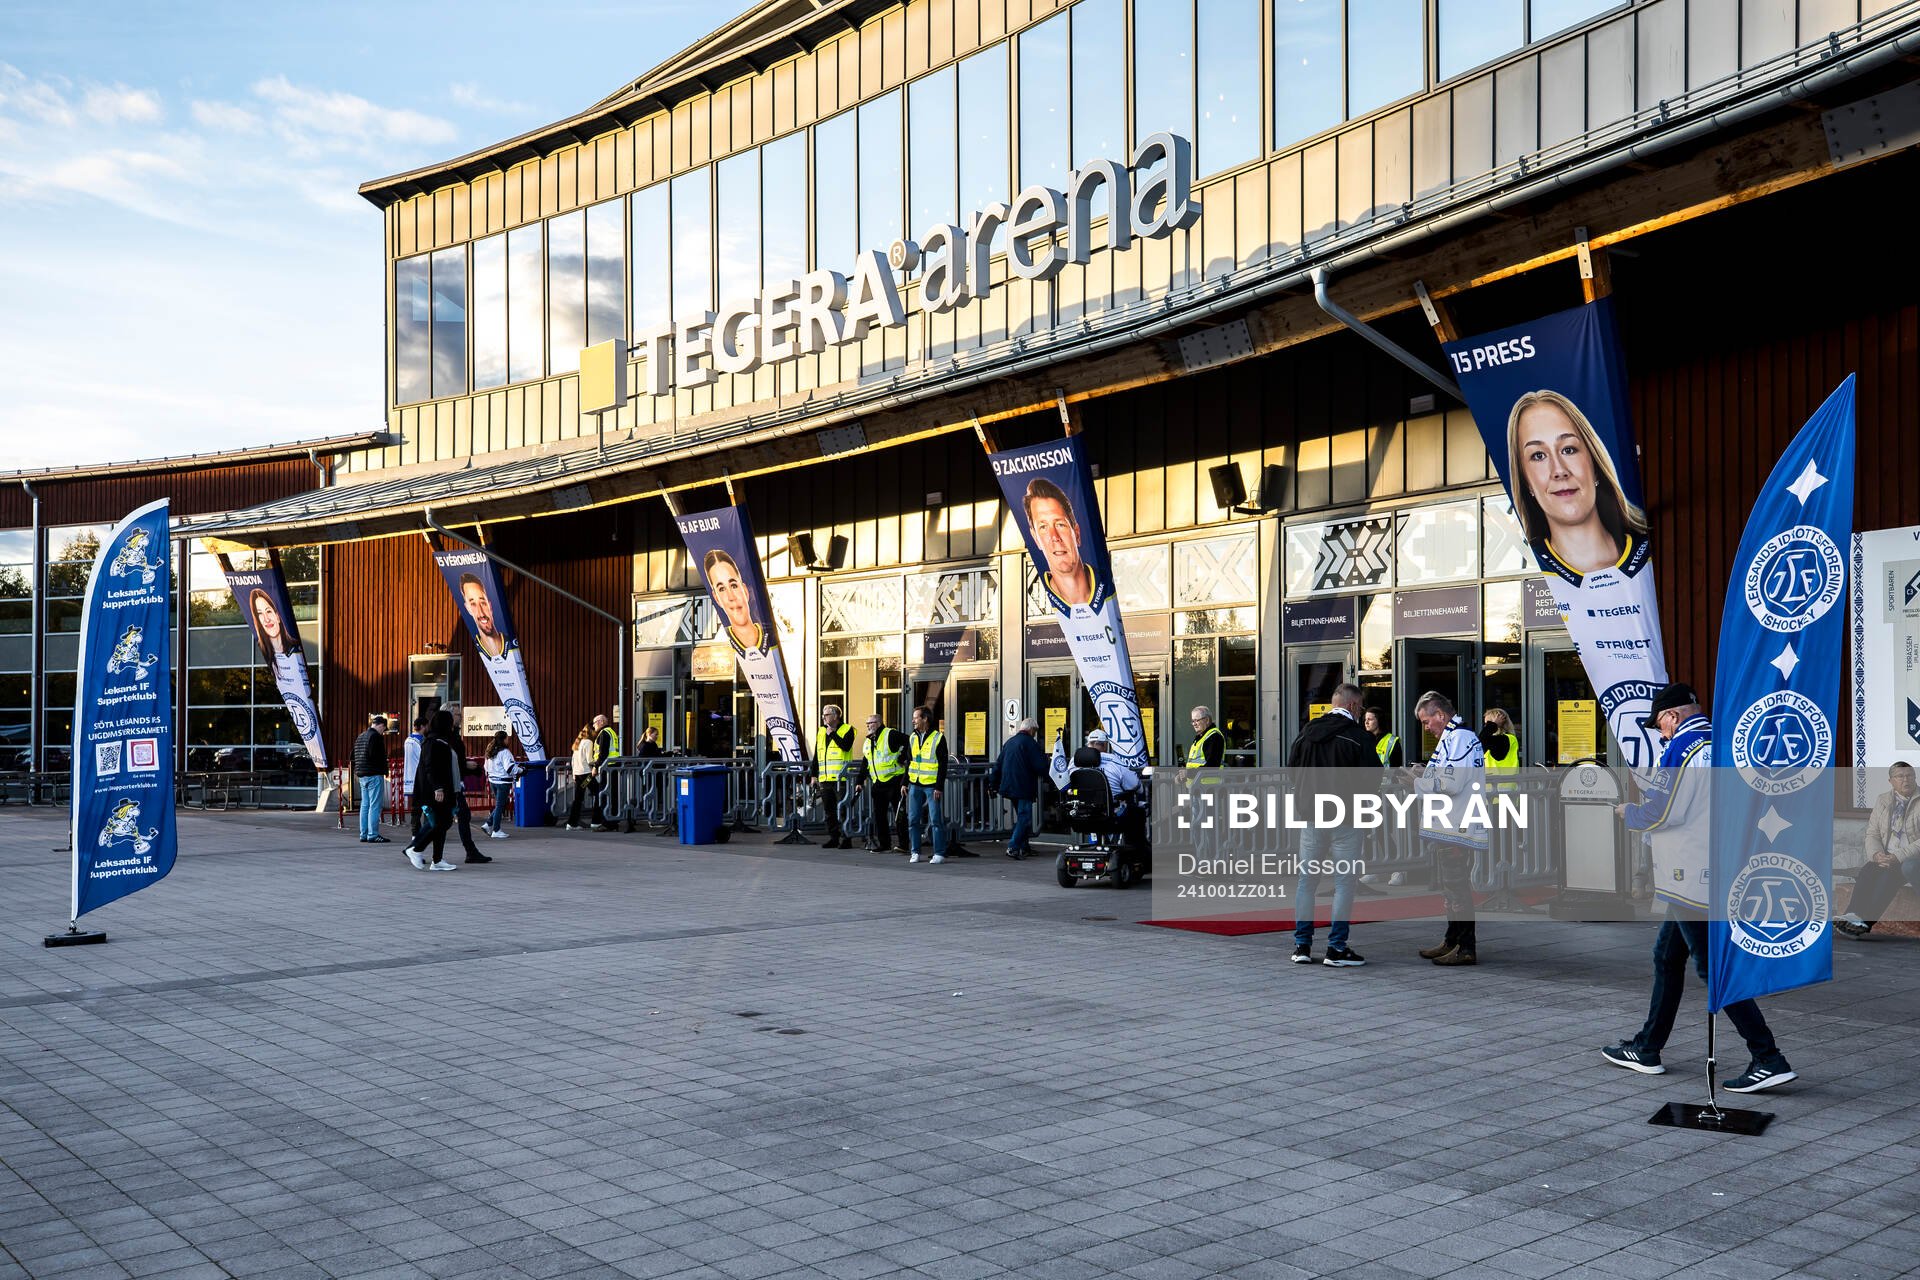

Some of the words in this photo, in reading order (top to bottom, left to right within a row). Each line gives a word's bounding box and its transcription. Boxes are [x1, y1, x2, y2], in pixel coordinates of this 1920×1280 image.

[919, 132, 1201, 313] arena
[1450, 351, 1472, 373] 15
[1472, 335, 1536, 370] PRESS
[1001, 447, 1074, 475] ZACKRISSON
[688, 520, 698, 533] AF
[699, 517, 720, 532] BJUR
[1549, 559, 1576, 582] TEGERA
[1747, 542, 1778, 608] LEKSANDS
[235, 575, 263, 586] RADOVA
[1403, 605, 1469, 618] BILJETTINNEHAVARE
[1291, 615, 1347, 628] BILJETTINNEHAVARE
[103, 684, 138, 695] Leksans
[1009, 704, 1015, 716] 4
[467, 723, 483, 733] puck
[1735, 704, 1763, 770] LEKSANDS
[94, 857, 141, 868] Leksands
[143, 856, 152, 864] IF
[1739, 937, 1806, 956] ISHOCKEY
